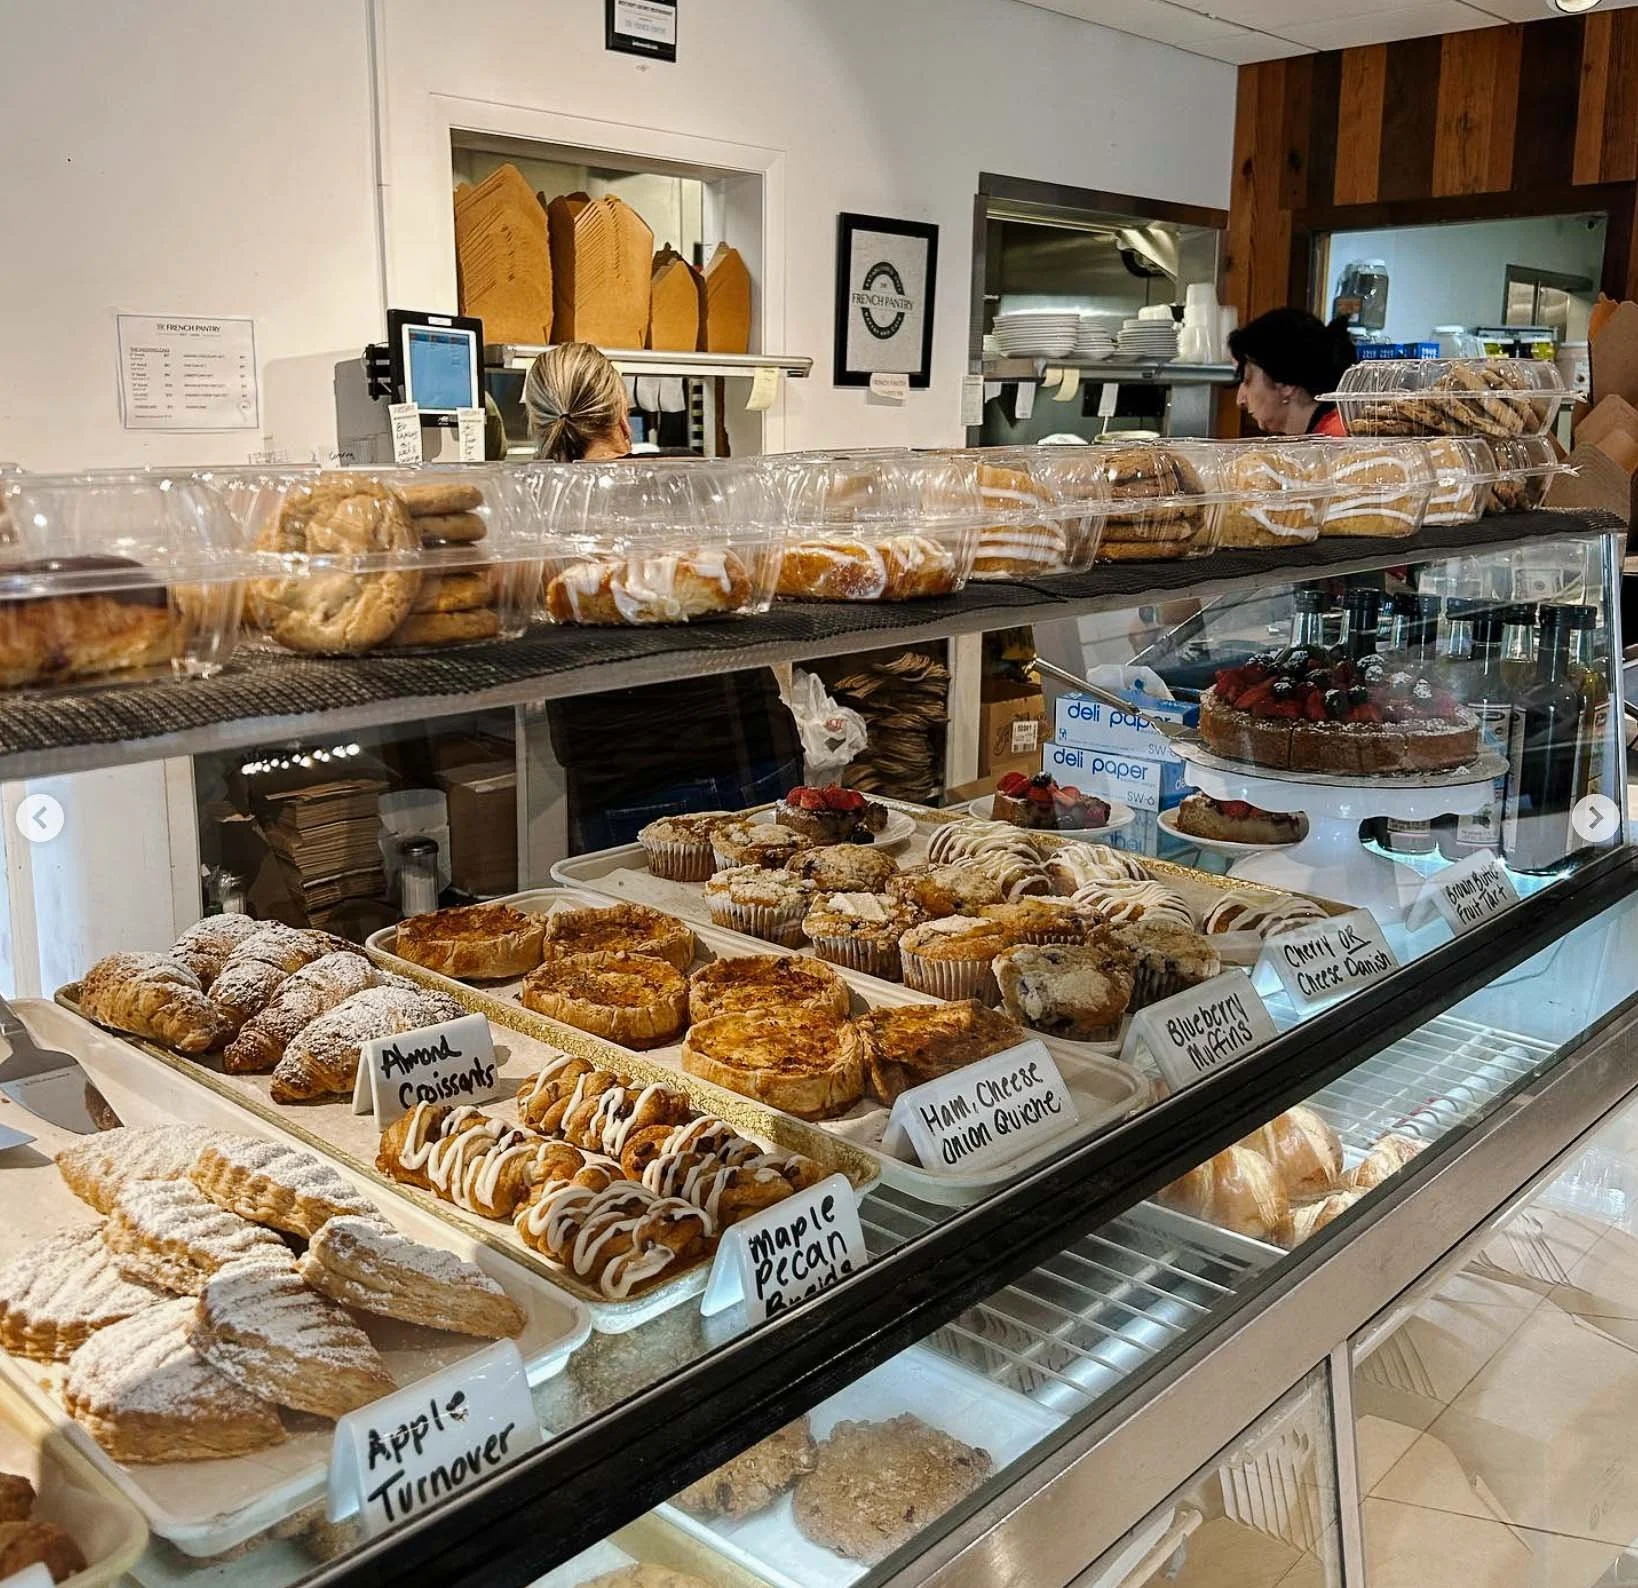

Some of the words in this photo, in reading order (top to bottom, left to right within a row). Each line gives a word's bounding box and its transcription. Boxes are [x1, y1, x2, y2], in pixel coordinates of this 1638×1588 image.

[852, 293, 884, 306] FRENCH
[885, 296, 913, 311] PANTRY
[1067, 702, 1100, 722] deli
[1110, 711, 1171, 731] pap
[1053, 748, 1083, 769] deli
[1092, 758, 1148, 780] paper
[1127, 791, 1155, 806] SW-6
[1283, 936, 1336, 968] Cherry
[1297, 964, 1344, 996] Cheese
[1344, 949, 1392, 977] Danish
[1166, 993, 1249, 1047] Blueberry
[381, 1034, 462, 1079] Almond
[1186, 1020, 1253, 1072] Muffins
[920, 1095, 978, 1136] Ham,
[975, 1062, 1044, 1107] Cheese
[993, 1090, 1061, 1135] Quiche
[368, 1390, 466, 1470] Apple
[367, 1422, 515, 1522] Turnover
